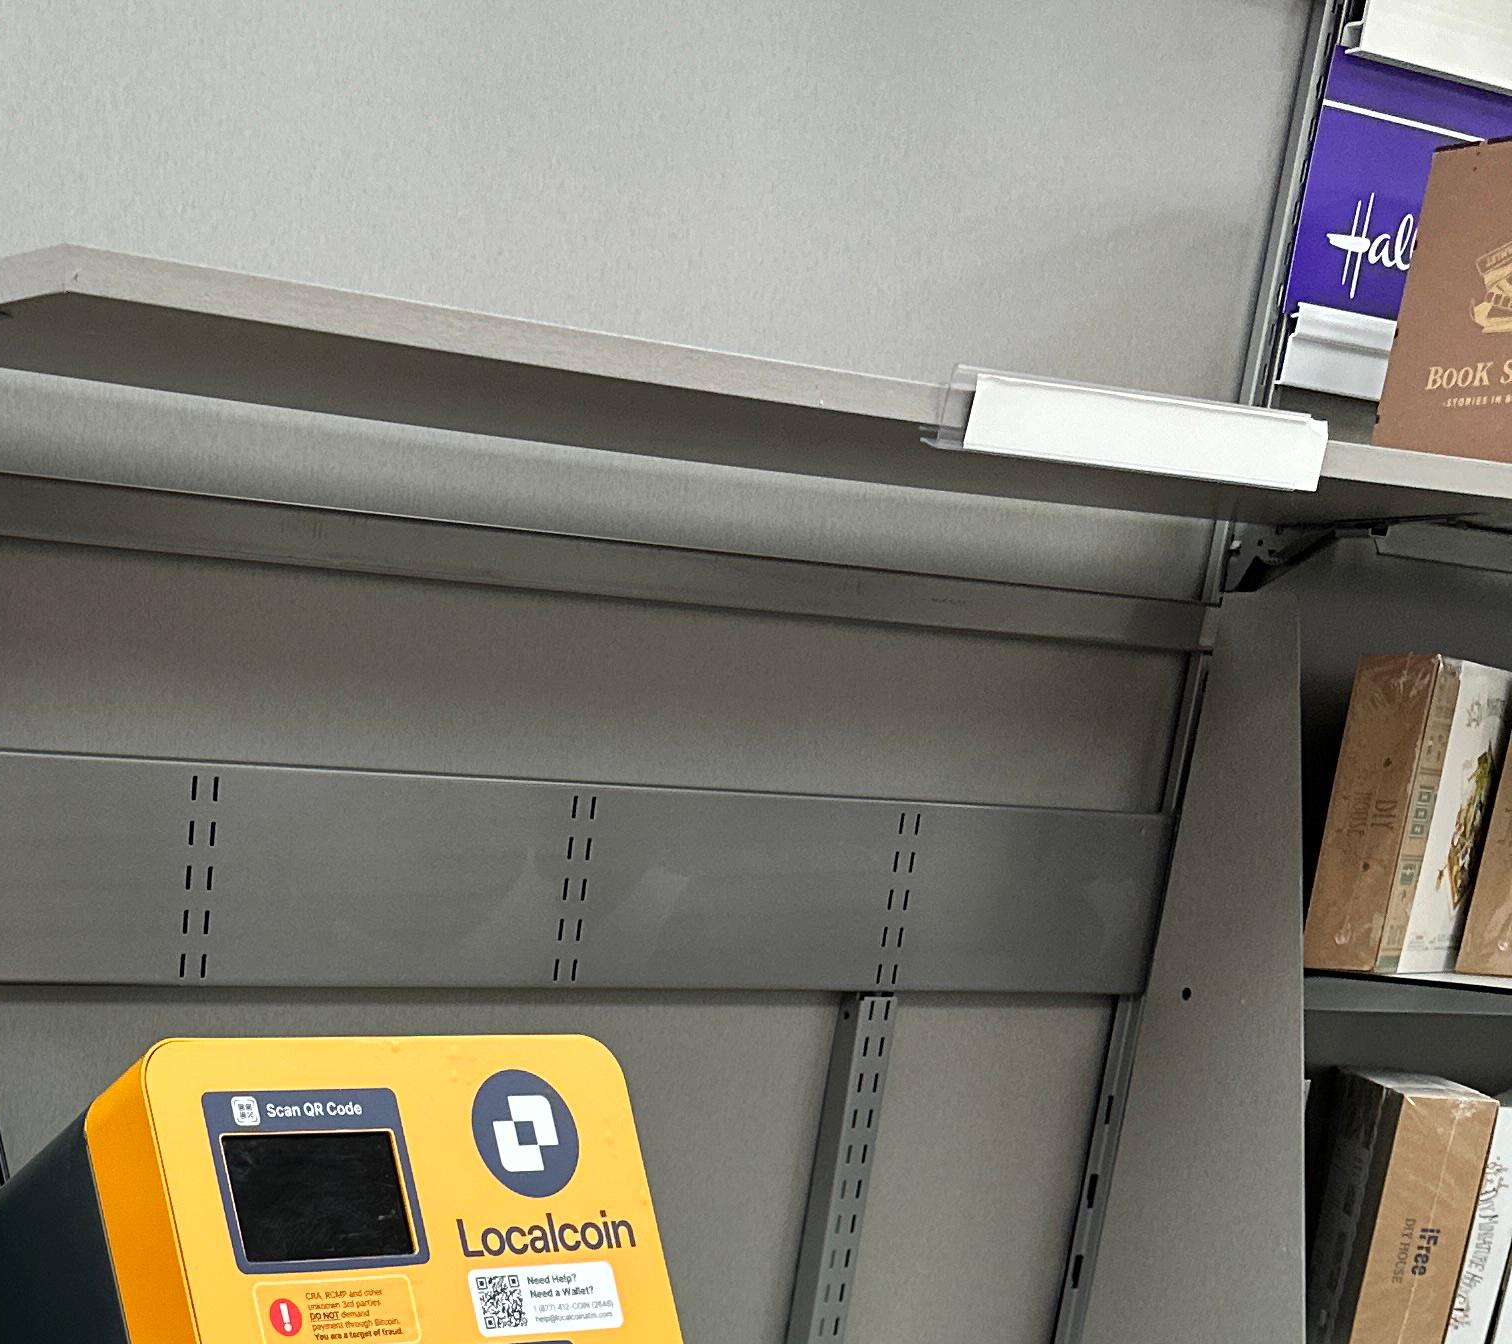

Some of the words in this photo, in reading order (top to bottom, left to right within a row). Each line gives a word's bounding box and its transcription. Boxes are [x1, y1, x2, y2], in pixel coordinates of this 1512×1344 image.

[1326, 192, 1417, 299] Hal
[1425, 361, 1494, 390] BOOK
[266, 1104, 301, 1117] Scan
[305, 1103, 324, 1120] QR
[327, 1102, 363, 1115] Code
[456, 1210, 637, 1257] Localcoin
[1400, 1218, 1416, 1239] DIY
[1392, 1243, 1409, 1284] HOUSE
[527, 1276, 550, 1285] Need
[552, 1273, 576, 1283] Help?
